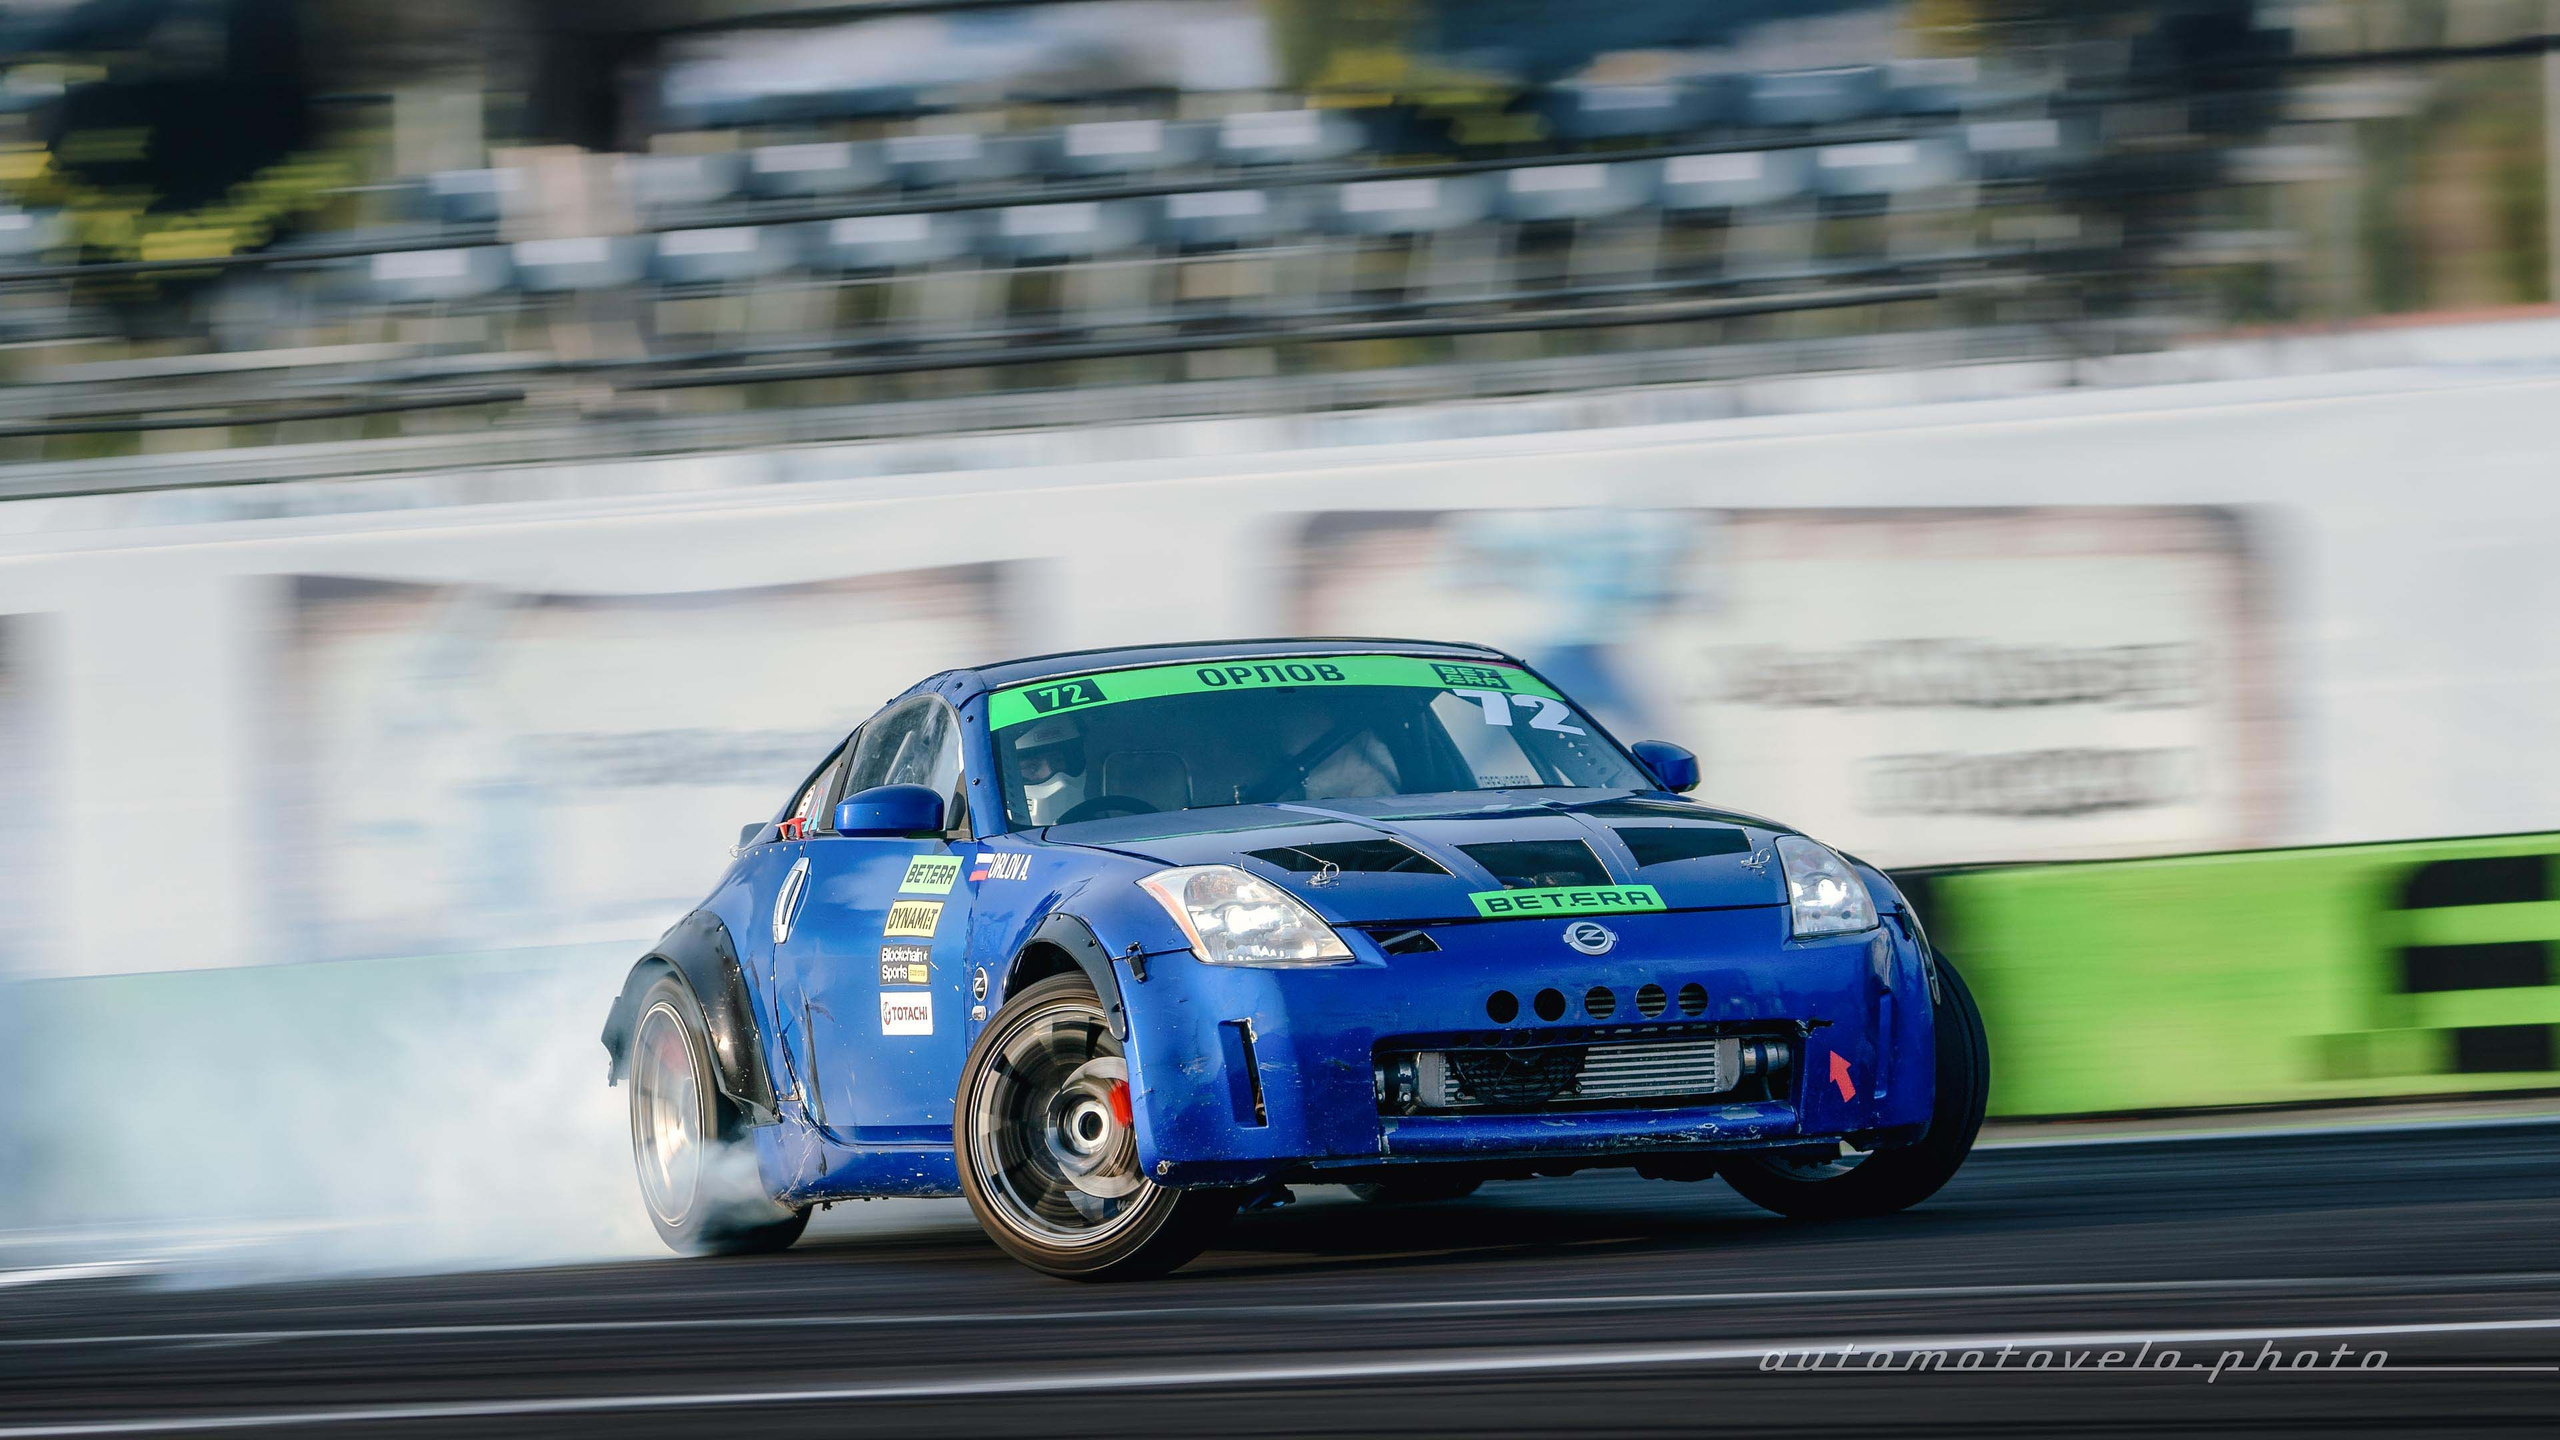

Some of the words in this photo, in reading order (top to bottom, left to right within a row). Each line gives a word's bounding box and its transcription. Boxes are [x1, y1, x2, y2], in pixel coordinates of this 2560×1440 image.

[1196, 664, 1345, 687] ОРЛОВ
[1038, 684, 1091, 708] 72
[1452, 688, 1586, 736] 72
[988, 853, 1025, 880] ORLOV
[882, 948, 923, 962] Blockchain
[882, 965, 907, 982] Sports
[892, 1006, 928, 1021] TOTACHI
